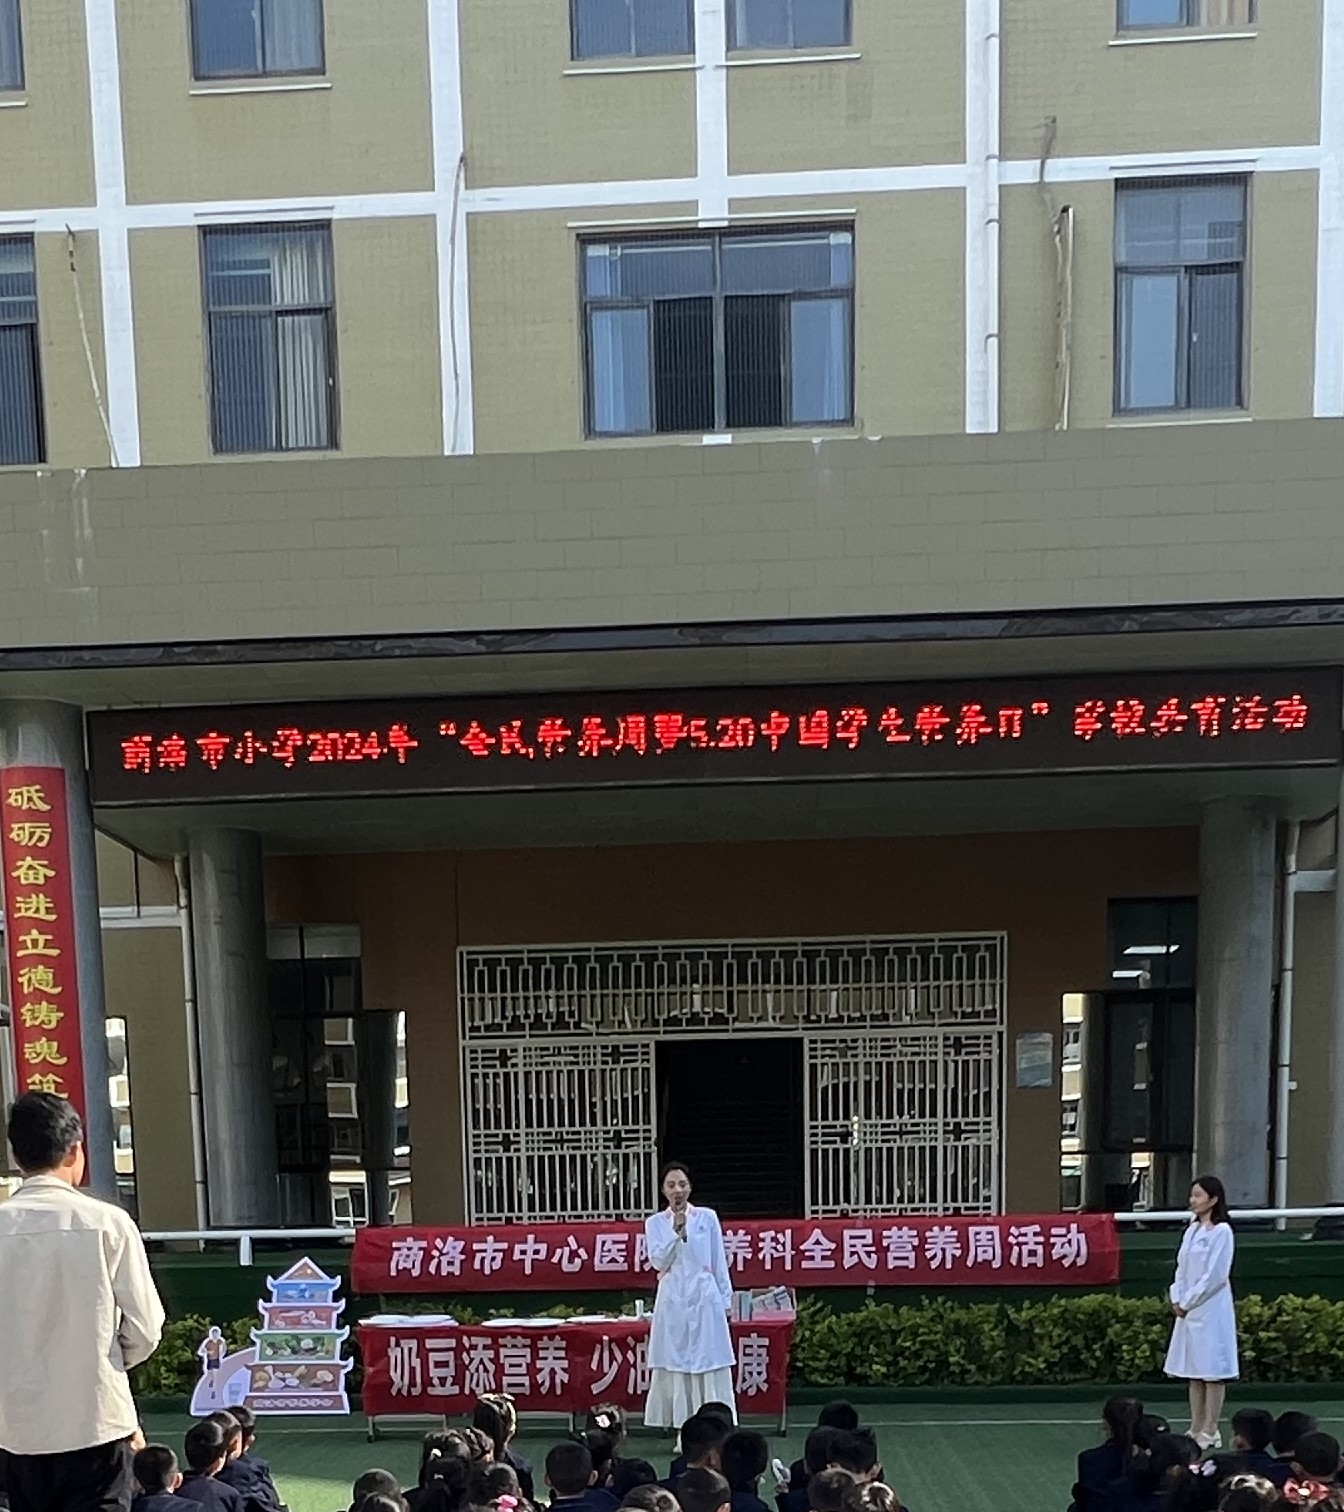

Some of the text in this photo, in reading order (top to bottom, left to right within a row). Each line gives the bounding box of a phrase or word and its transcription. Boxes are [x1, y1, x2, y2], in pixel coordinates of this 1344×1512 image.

[389, 1221, 1088, 1277] 商洛市中心医养科全民营养周活动
[387, 1332, 770, 1397] 奶豆添营养 少油康
